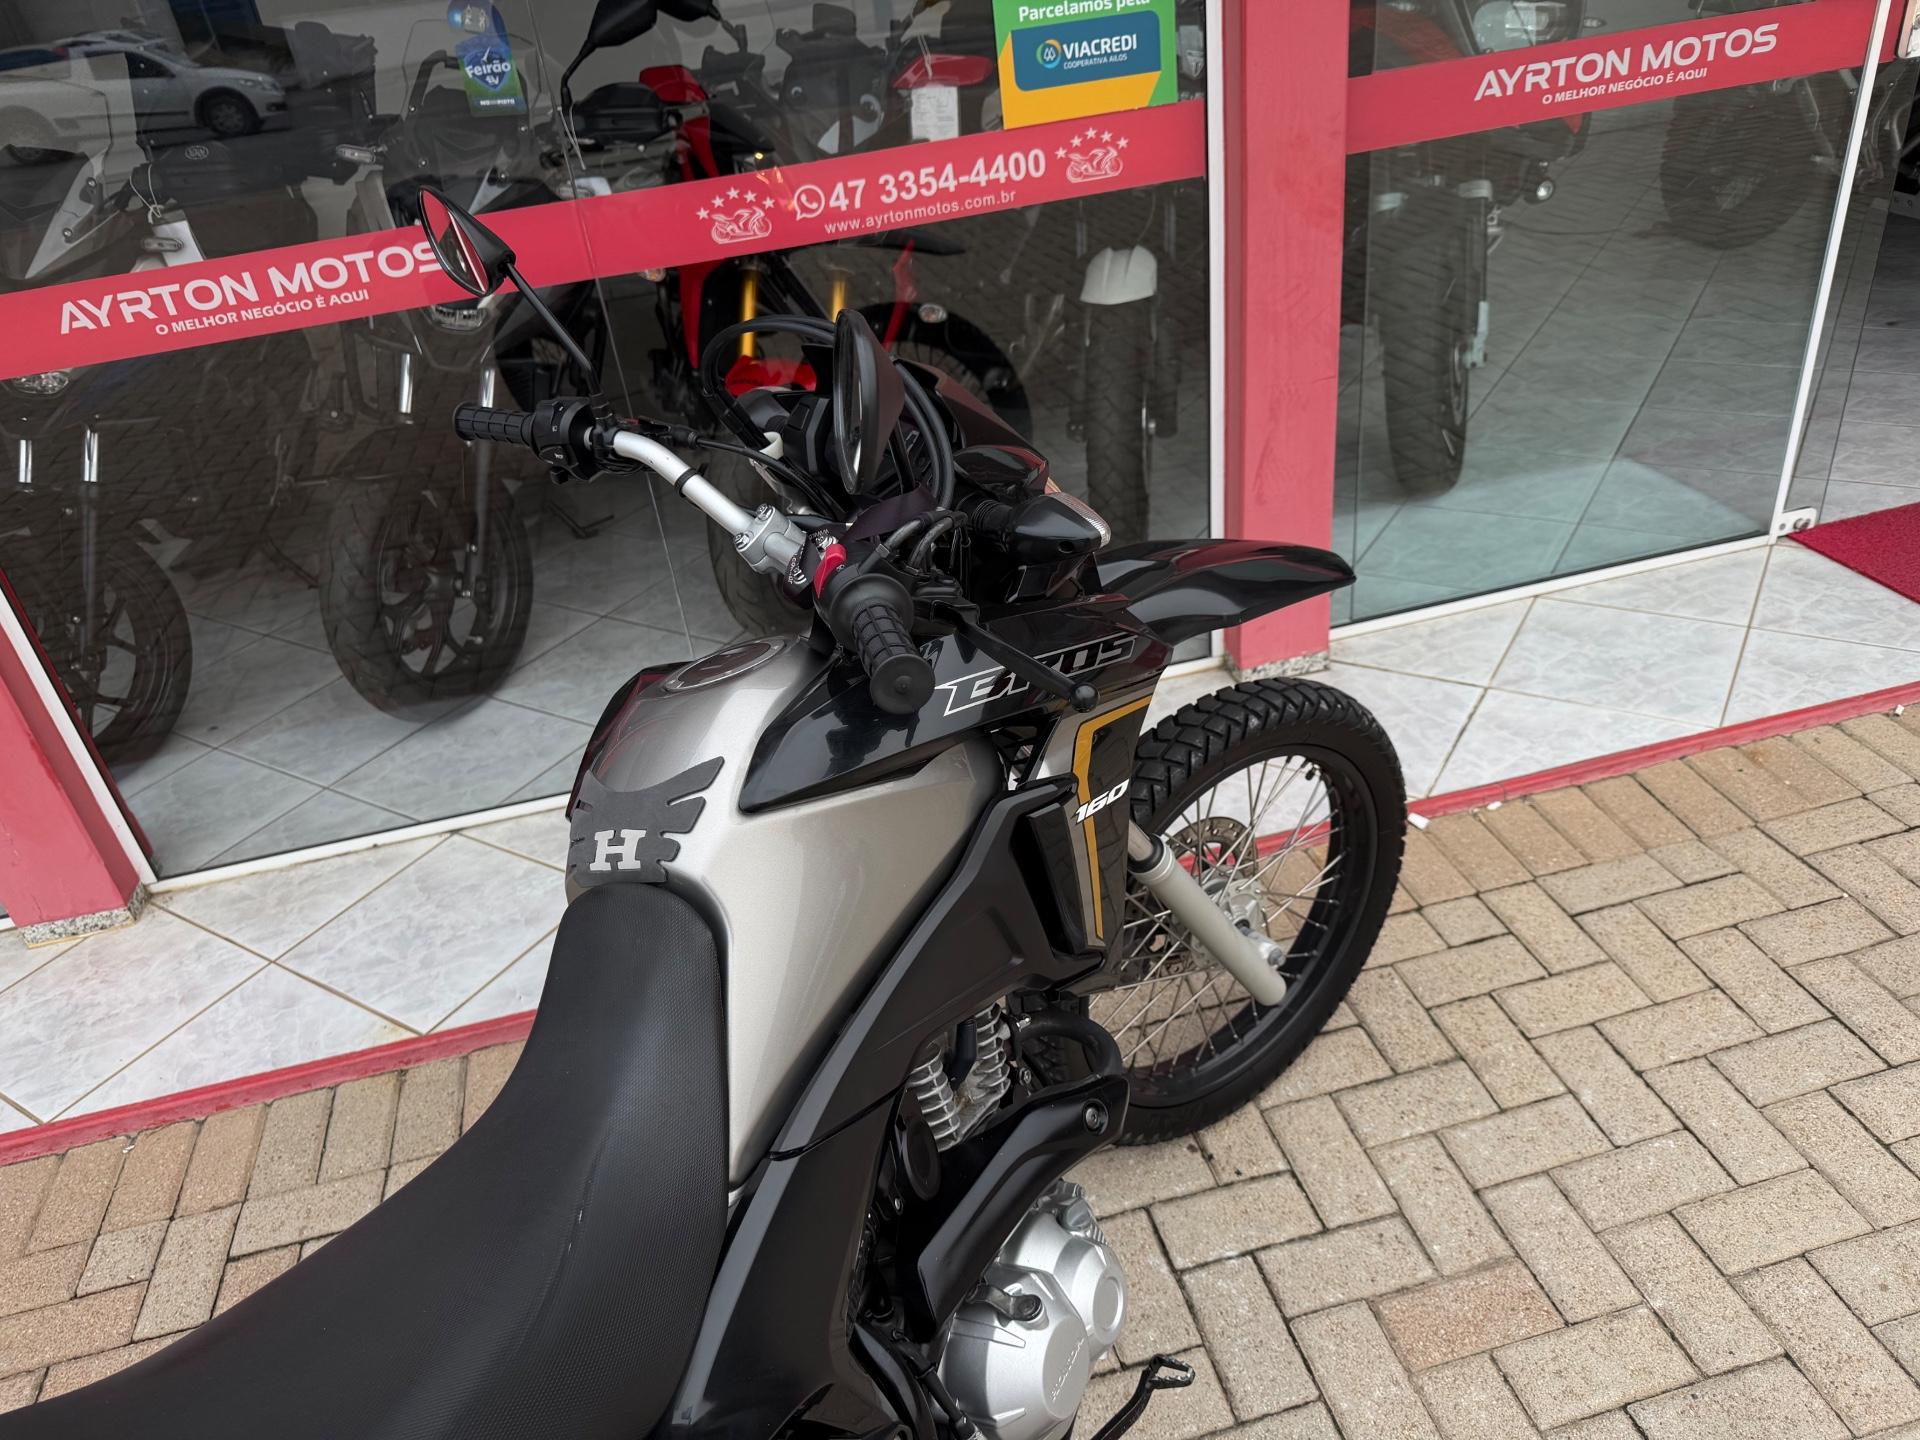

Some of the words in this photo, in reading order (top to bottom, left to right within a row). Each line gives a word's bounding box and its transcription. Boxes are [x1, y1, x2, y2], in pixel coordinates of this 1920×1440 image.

[1018, 0, 1113, 22] Parcelamos
[1062, 33, 1137, 59] VIACREDI
[1063, 55, 1108, 70] COOPERATIVA
[1474, 47, 1632, 101] AYRTON
[1640, 23, 1780, 73] MOTOS
[464, 59, 512, 79] Feirão
[1541, 94, 1553, 105] O
[1554, 84, 1607, 103] MELHOR
[1608, 74, 1664, 94] NEGÓCIO
[1665, 72, 1675, 84] É
[1675, 67, 1708, 82] AQUI
[828, 178, 867, 212] 47
[878, 148, 1046, 204] 3354-4400
[824, 190, 1016, 234] www.ayrtonmotos.com.br
[60, 271, 261, 335] AYRTON
[267, 241, 443, 298] MOTOS
[155, 323, 169, 335] O
[172, 311, 239, 334] MELHOR
[240, 299, 313, 322] NEGÓCIO
[315, 293, 326, 309] É
[329, 289, 370, 306] AQUI
[1074, 778, 1130, 824] 160
[589, 828, 648, 872] H
